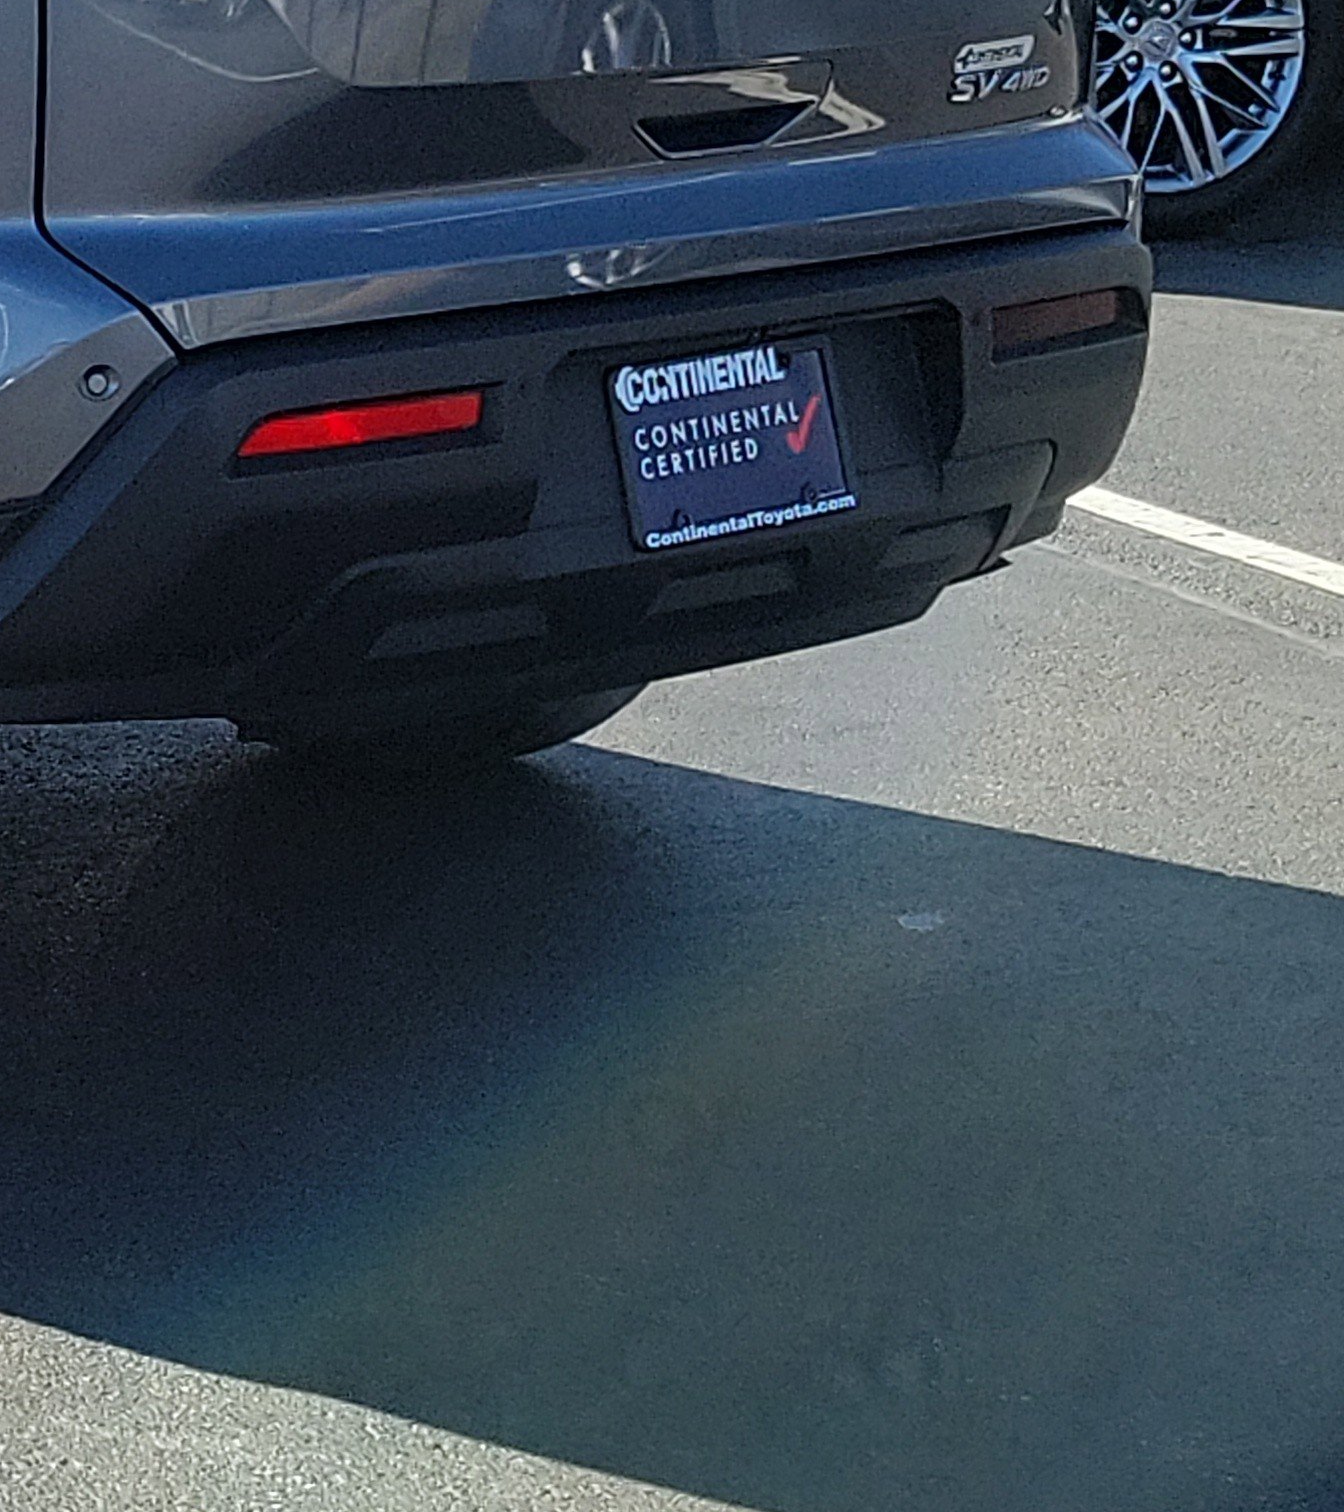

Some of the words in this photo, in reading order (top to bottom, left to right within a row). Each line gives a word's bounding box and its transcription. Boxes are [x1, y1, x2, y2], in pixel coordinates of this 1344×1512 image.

[950, 70, 1000, 102] SV
[615, 346, 786, 412] CONTINENTAL
[634, 401, 800, 451] CONTINENTAL
[640, 438, 759, 480] CERTIFIED
[645, 494, 856, 548] ContinentalToyota.com
